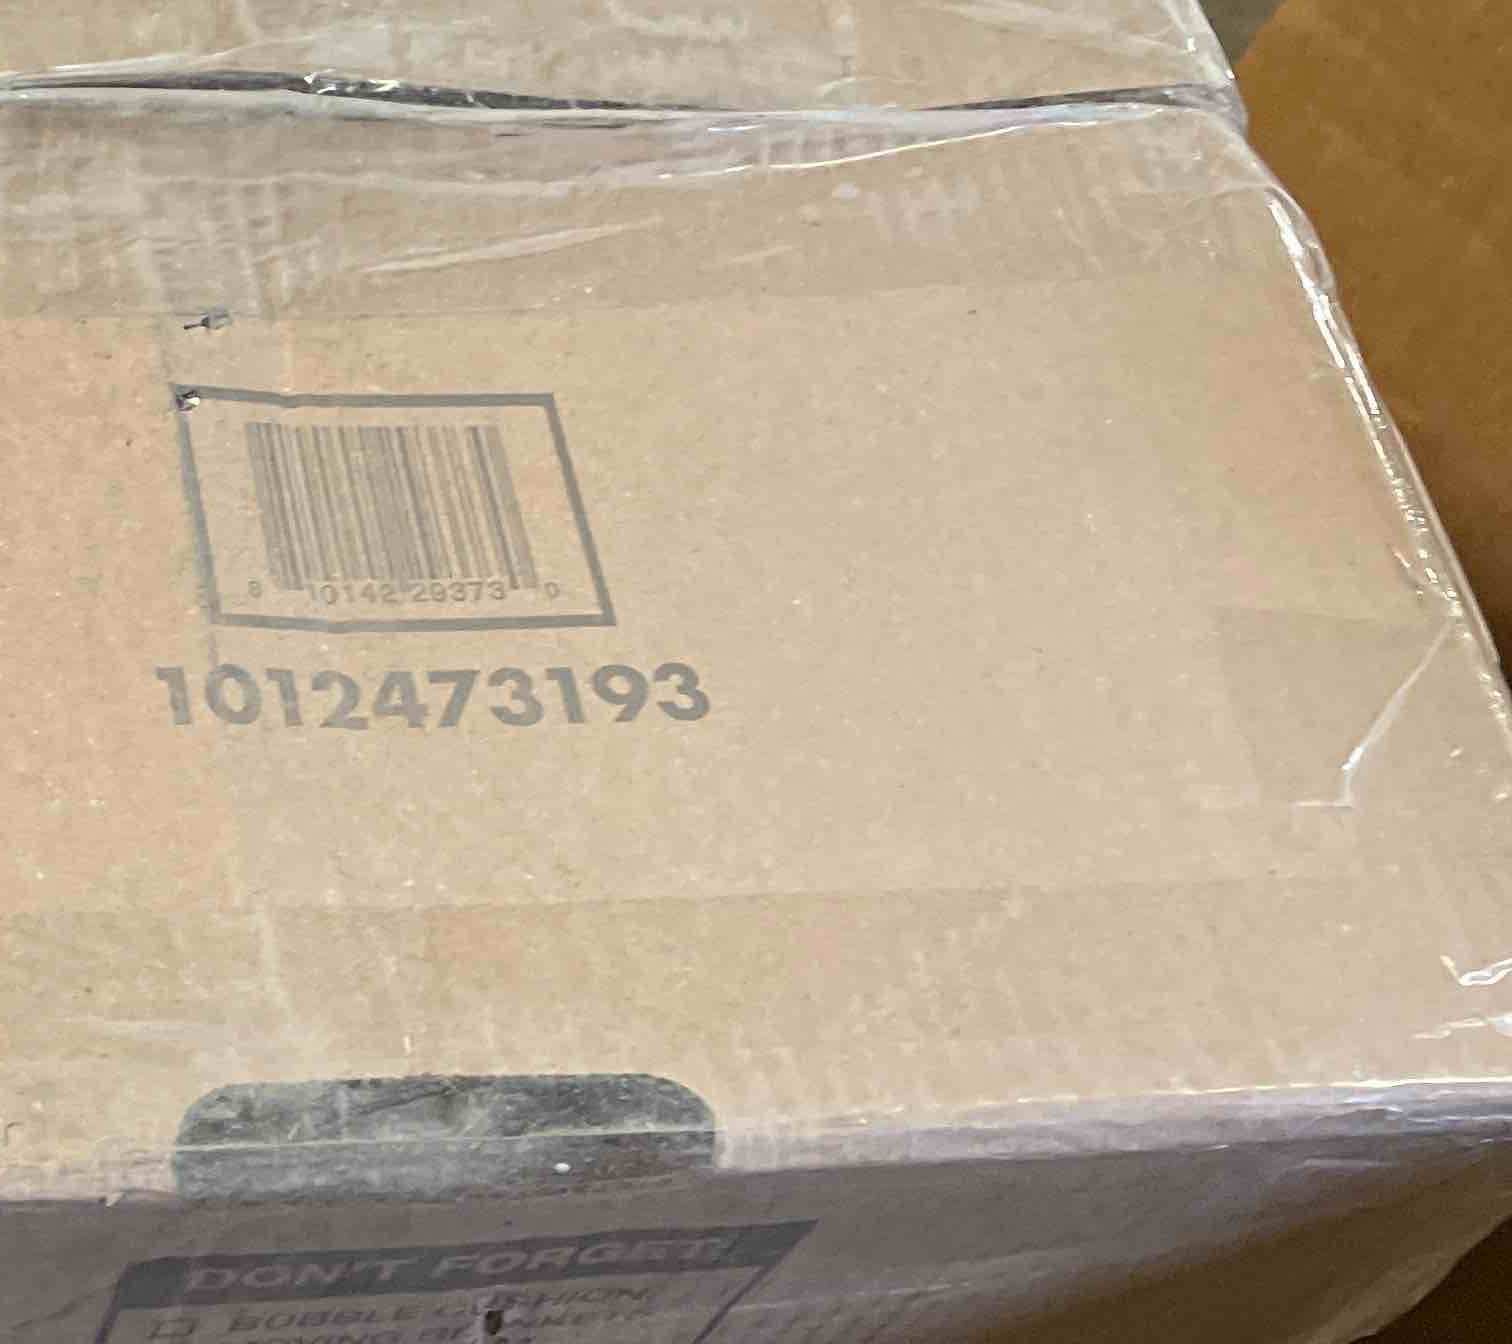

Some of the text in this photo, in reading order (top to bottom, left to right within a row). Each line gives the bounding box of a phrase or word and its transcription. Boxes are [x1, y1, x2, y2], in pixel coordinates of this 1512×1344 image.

[155, 660, 711, 730] 1012473193
[187, 1256, 418, 1292] DON'T
[227, 1304, 416, 1334] BUBBLE
[416, 1308, 654, 1344] BLNKETS
